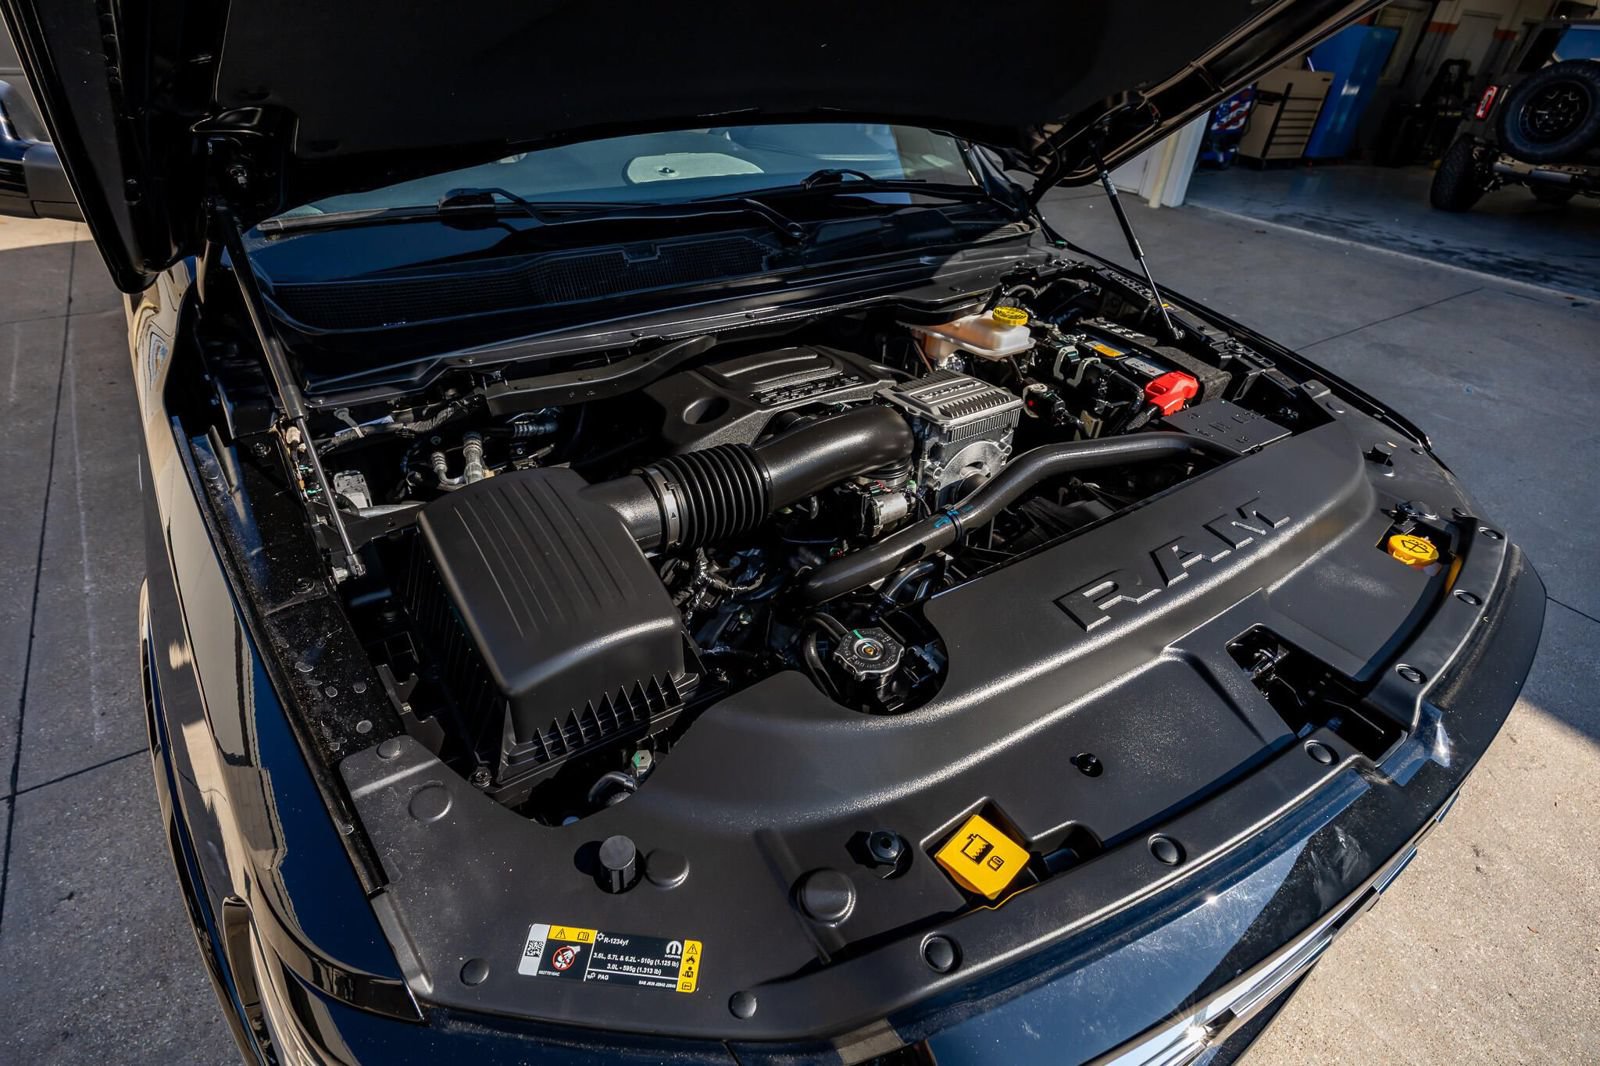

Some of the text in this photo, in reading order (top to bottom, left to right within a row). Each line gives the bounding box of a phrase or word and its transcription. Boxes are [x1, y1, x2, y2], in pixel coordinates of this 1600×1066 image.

[1053, 497, 1291, 632] RAM
[603, 936, 630, 947] R-1234yf
[593, 952, 606, 960] 3.6L,
[607, 953, 618, 961] 5.7L
[625, 955, 636, 963] 6.2L
[640, 957, 654, 966] 510g
[597, 973, 609, 981] PAG
[653, 968, 662, 976] lb)
